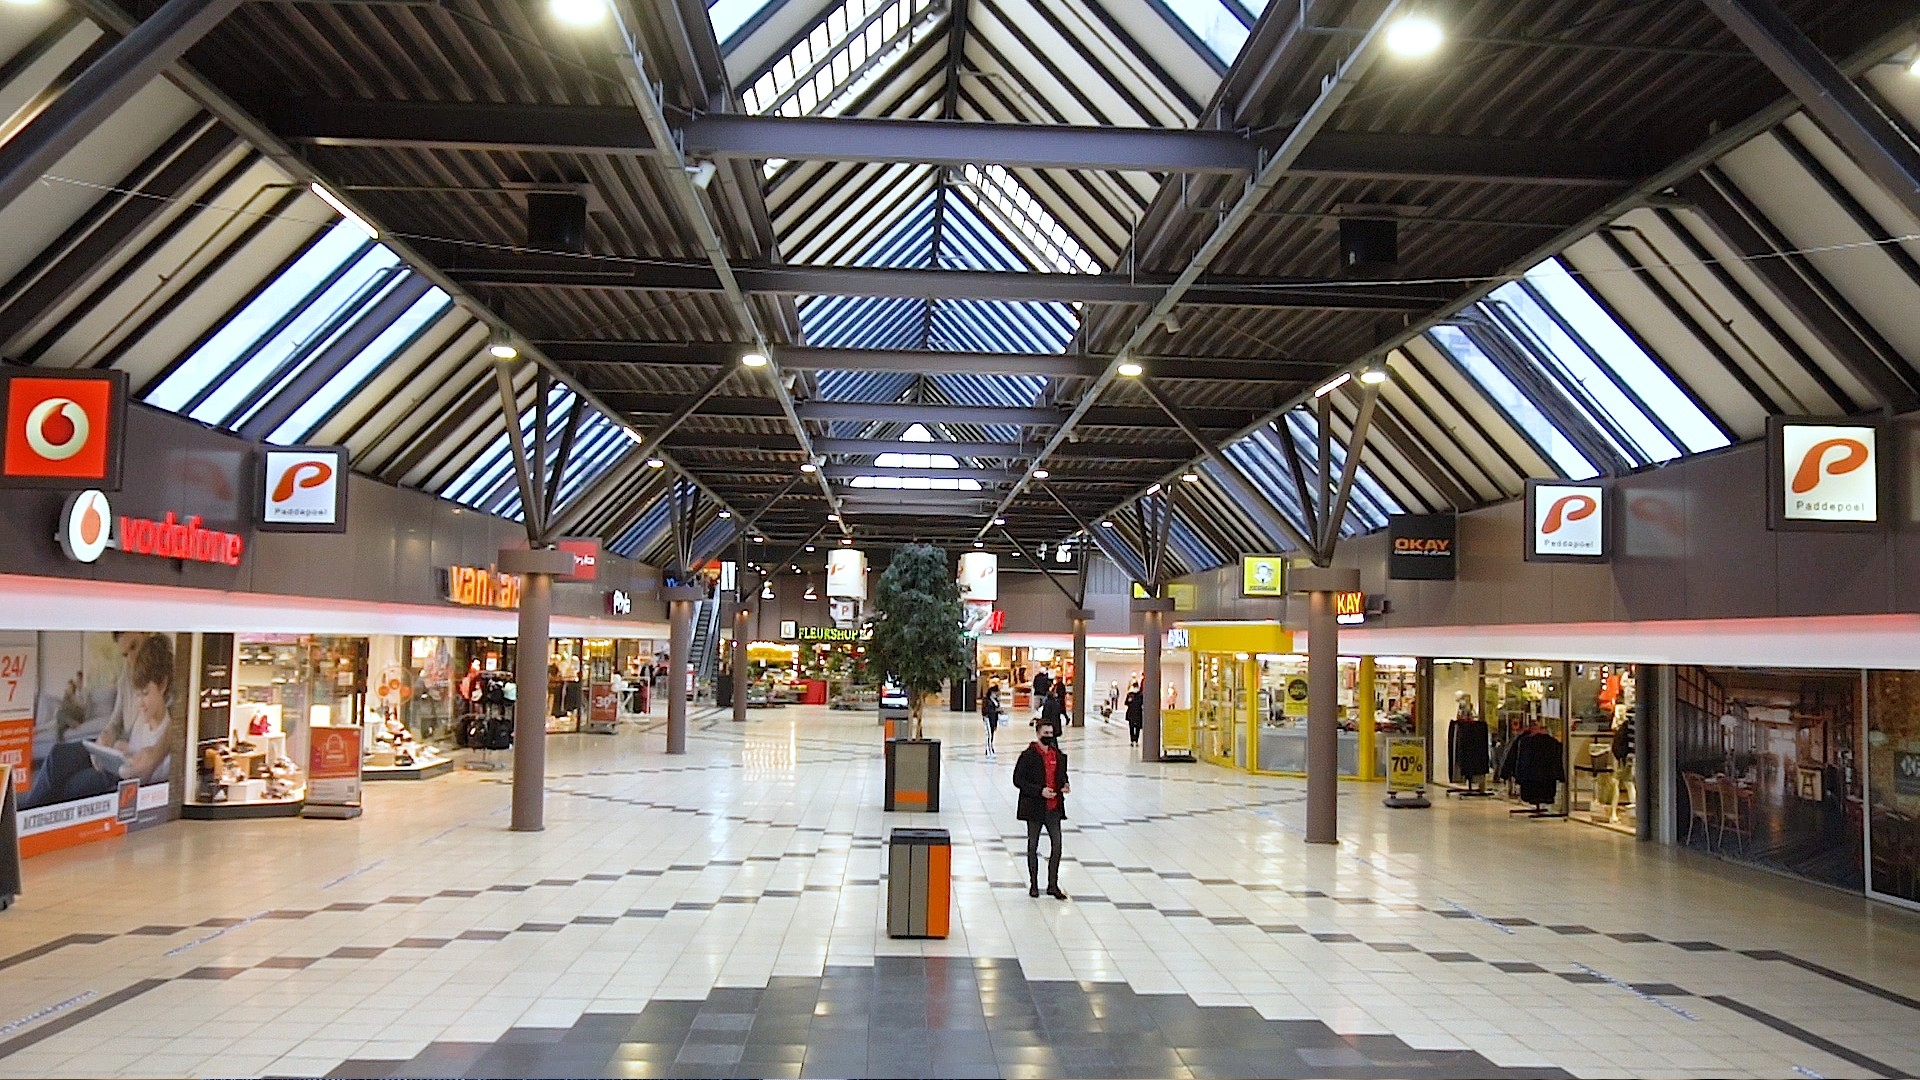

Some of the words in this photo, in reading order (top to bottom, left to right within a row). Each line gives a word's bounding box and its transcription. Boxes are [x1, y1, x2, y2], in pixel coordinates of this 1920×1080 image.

[1796, 500, 1865, 512] Paddepoel
[120, 511, 244, 567] vodafone
[1394, 537, 1450, 550] OKAY
[1544, 539, 1595, 548] Paddepoel
[1336, 592, 1362, 615] KAY
[7, 680, 18, 702] 7
[1391, 756, 1423, 773] 70%
